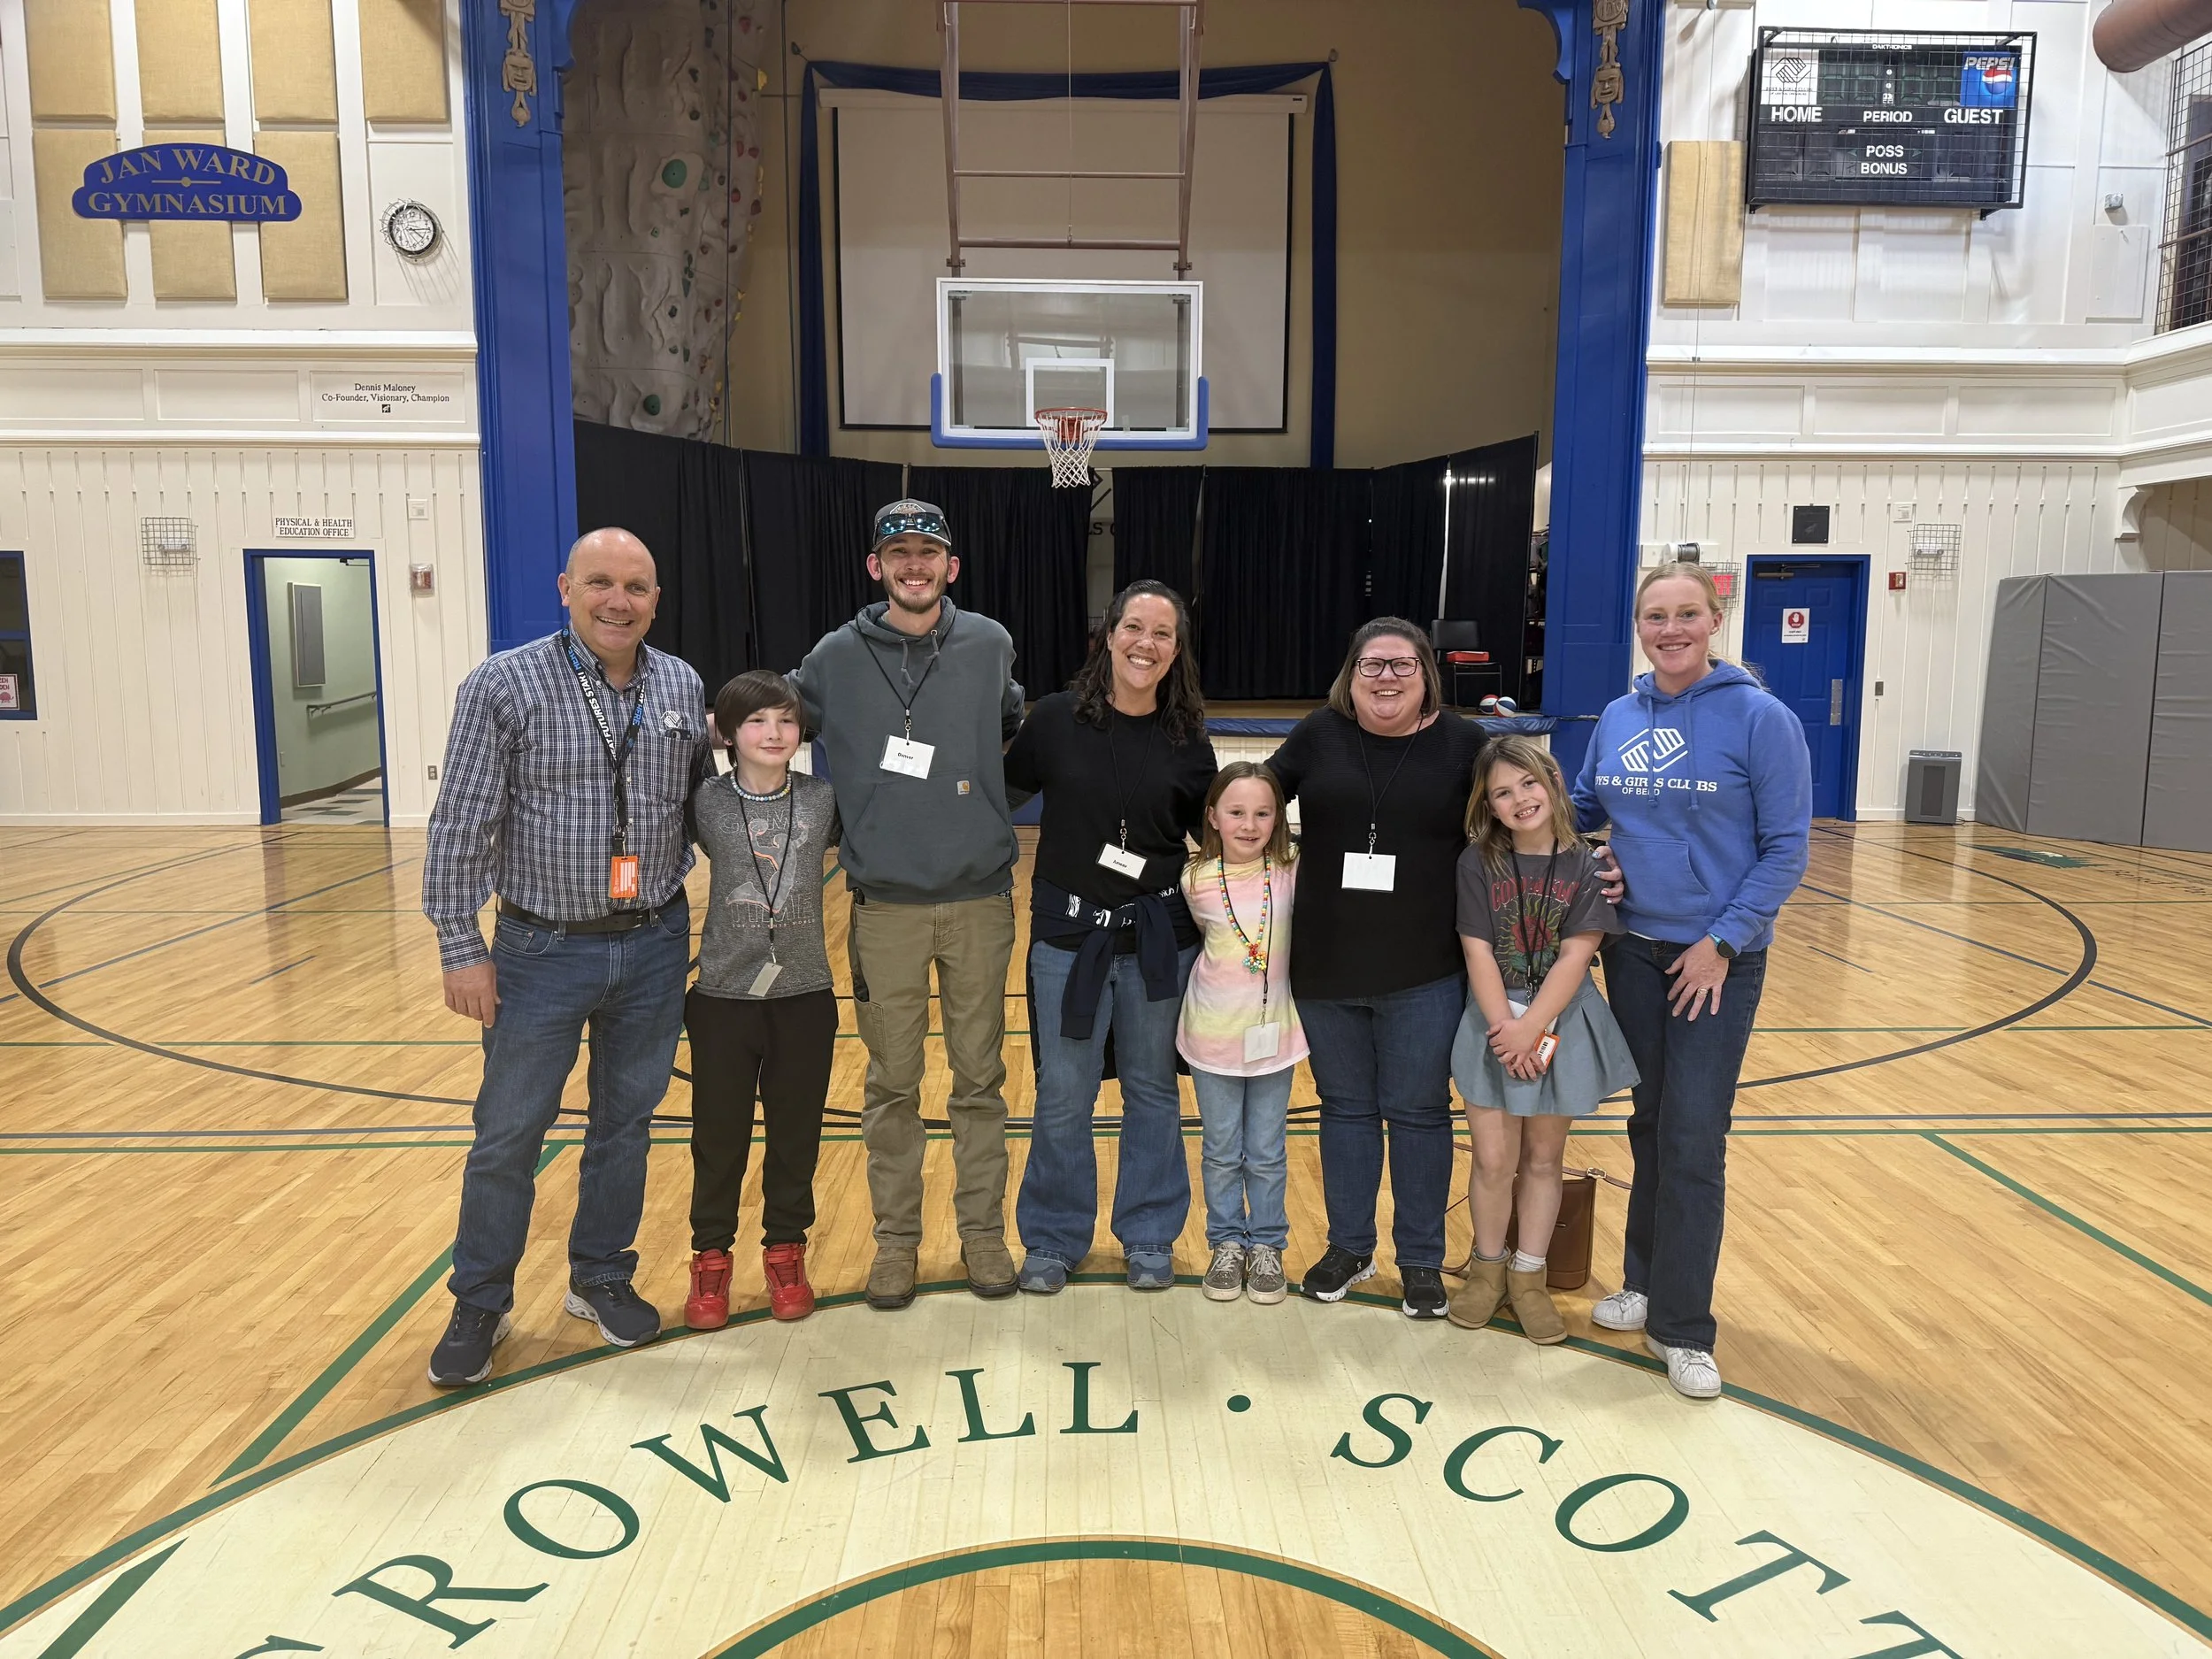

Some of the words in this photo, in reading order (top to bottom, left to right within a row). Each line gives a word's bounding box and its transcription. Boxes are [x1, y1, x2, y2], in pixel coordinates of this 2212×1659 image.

[1964, 57, 2016, 70] PEPSI
[1770, 106, 1823, 122] HOME
[1863, 111, 1913, 123] PERIOD
[1944, 109, 2003, 124] GUEST
[1866, 145, 1904, 157] POSS
[99, 150, 162, 184] JAN
[172, 149, 275, 185] WARD
[1861, 163, 1908, 175] BONUS
[88, 192, 288, 216] GYMNASIUM
[383, 384, 416, 393] Maloney
[321, 394, 369, 403] Co-Founder,
[371, 394, 409, 403] Visionary,
[411, 394, 449, 403] Champion
[275, 518, 311, 526] PHYSICAL
[322, 518, 352, 527] HEALTH
[280, 527, 320, 536] EDUCATION
[323, 527, 349, 536] OFFICE
[588, 696, 613, 739] FUTURES
[1611, 776, 1622, 786] &
[1624, 777, 1664, 787] GIRS
[232, 1362, 1139, 1659] ROWELL
